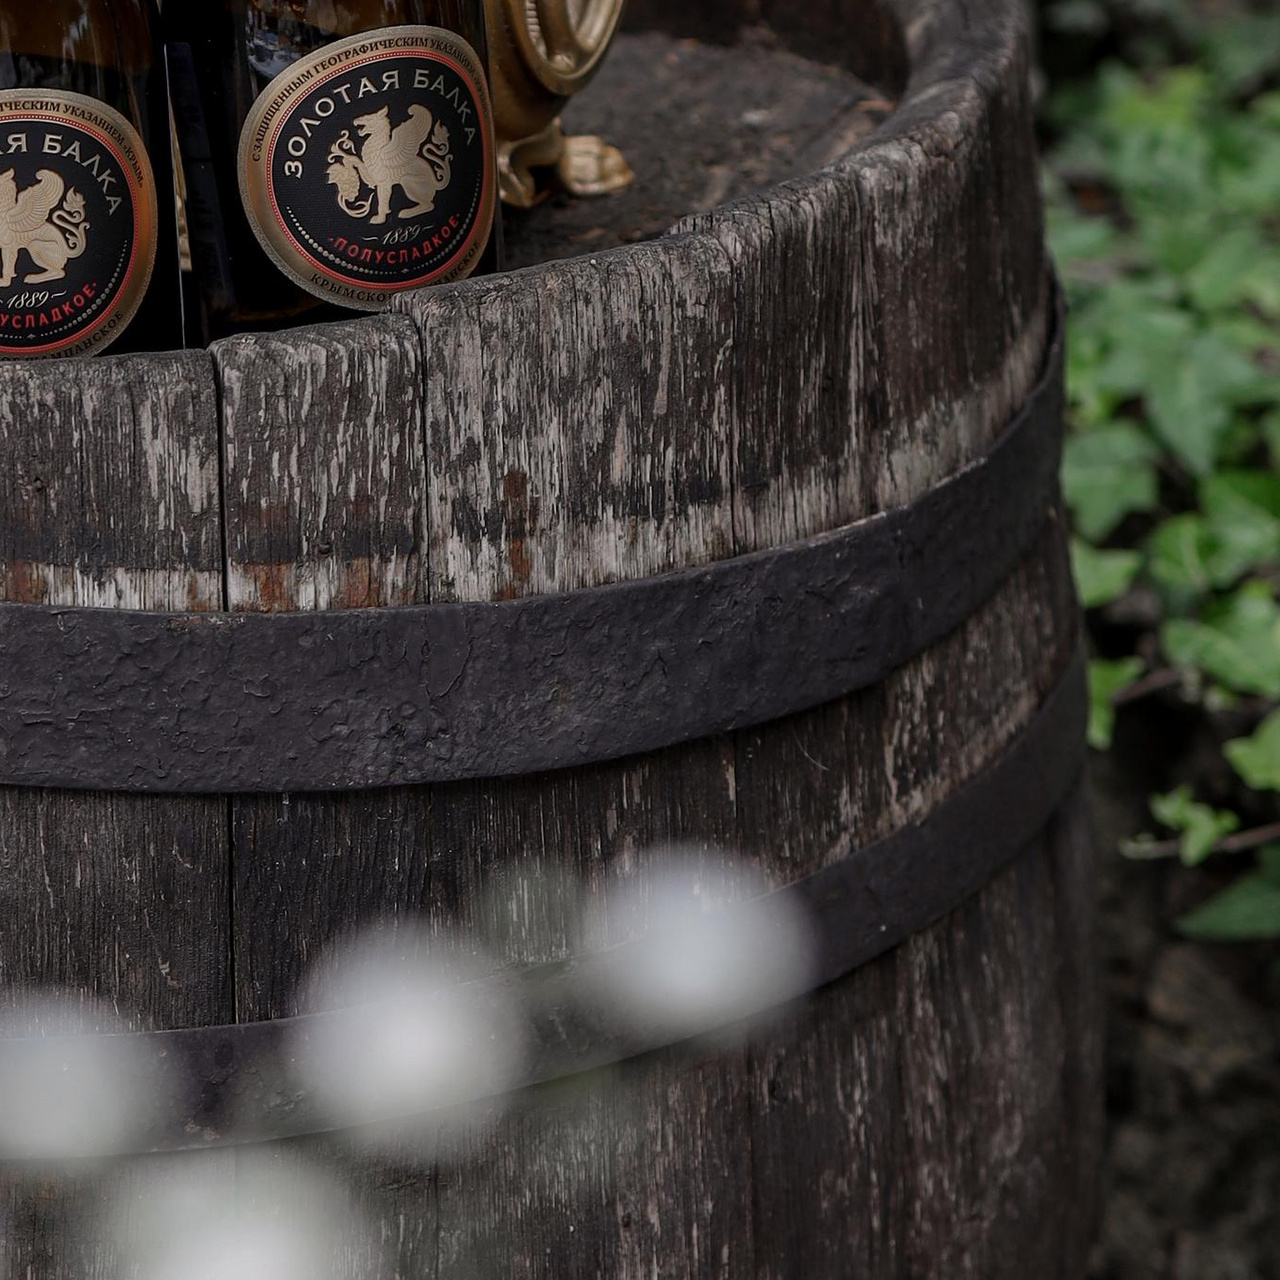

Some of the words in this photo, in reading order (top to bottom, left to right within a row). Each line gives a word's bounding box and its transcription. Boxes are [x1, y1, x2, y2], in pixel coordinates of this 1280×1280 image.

[252, 69, 314, 151] ЗАЩИЩЕННЫМ
[314, 37, 428, 74] ГЕОГРАФИЧЕСКИМ
[63, 104, 125, 144] УКАЗАНИЕМ
[284, 69, 400, 178] ЗОЛОТАЯ
[413, 69, 476, 146] БАЛКА
[42, 134, 122, 216] БАЛКА
[337, 215, 458, 264] ПОЛУСЛАДКОЕ
[382, 225, 422, 244] 1889
[7, 292, 49, 308] 1889
[311, 273, 393, 302] КРЫМСКО
